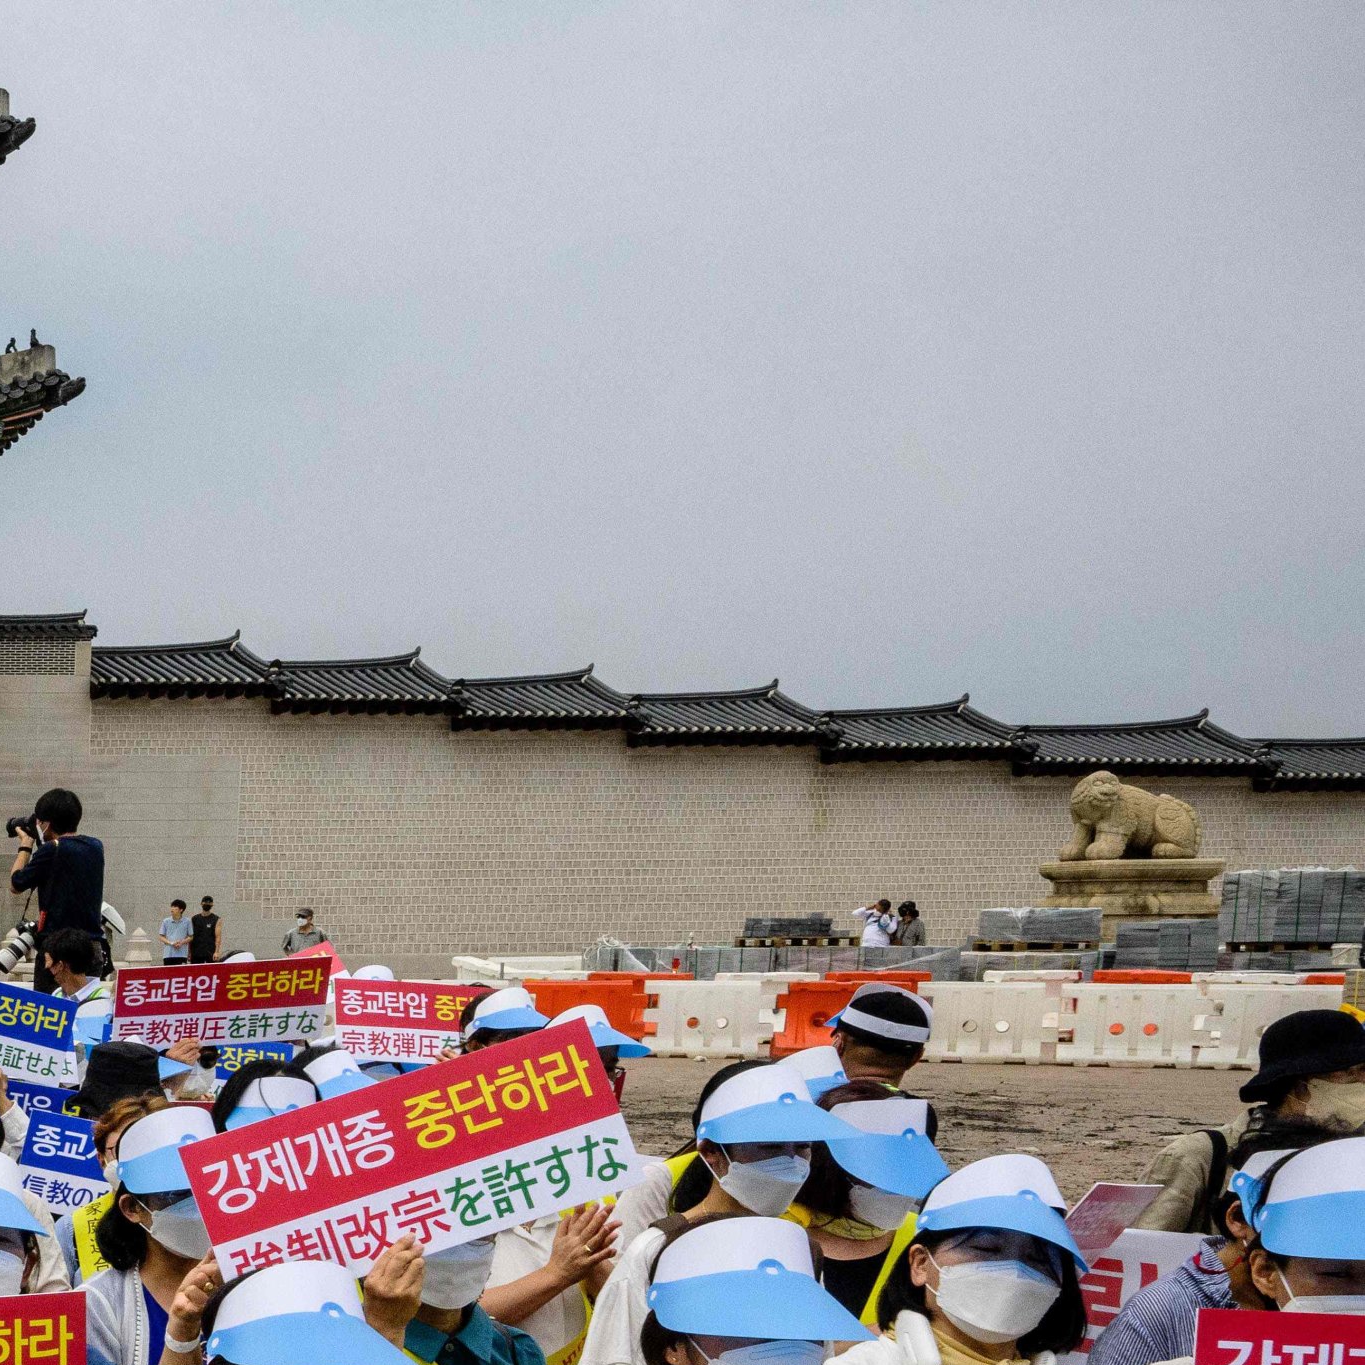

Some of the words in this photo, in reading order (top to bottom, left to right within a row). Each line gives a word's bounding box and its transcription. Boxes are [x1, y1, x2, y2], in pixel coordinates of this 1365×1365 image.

[122, 974, 219, 1007] 종교탄압
[225, 968, 324, 1000] 중단하라
[340, 989, 429, 1020] 종교탄압
[118, 1009, 319, 1044] 宗教弾圧を許すな
[32, 1123, 98, 1161] 종교
[202, 1110, 395, 1215] 강제개종
[403, 1044, 595, 1150] 중단하라
